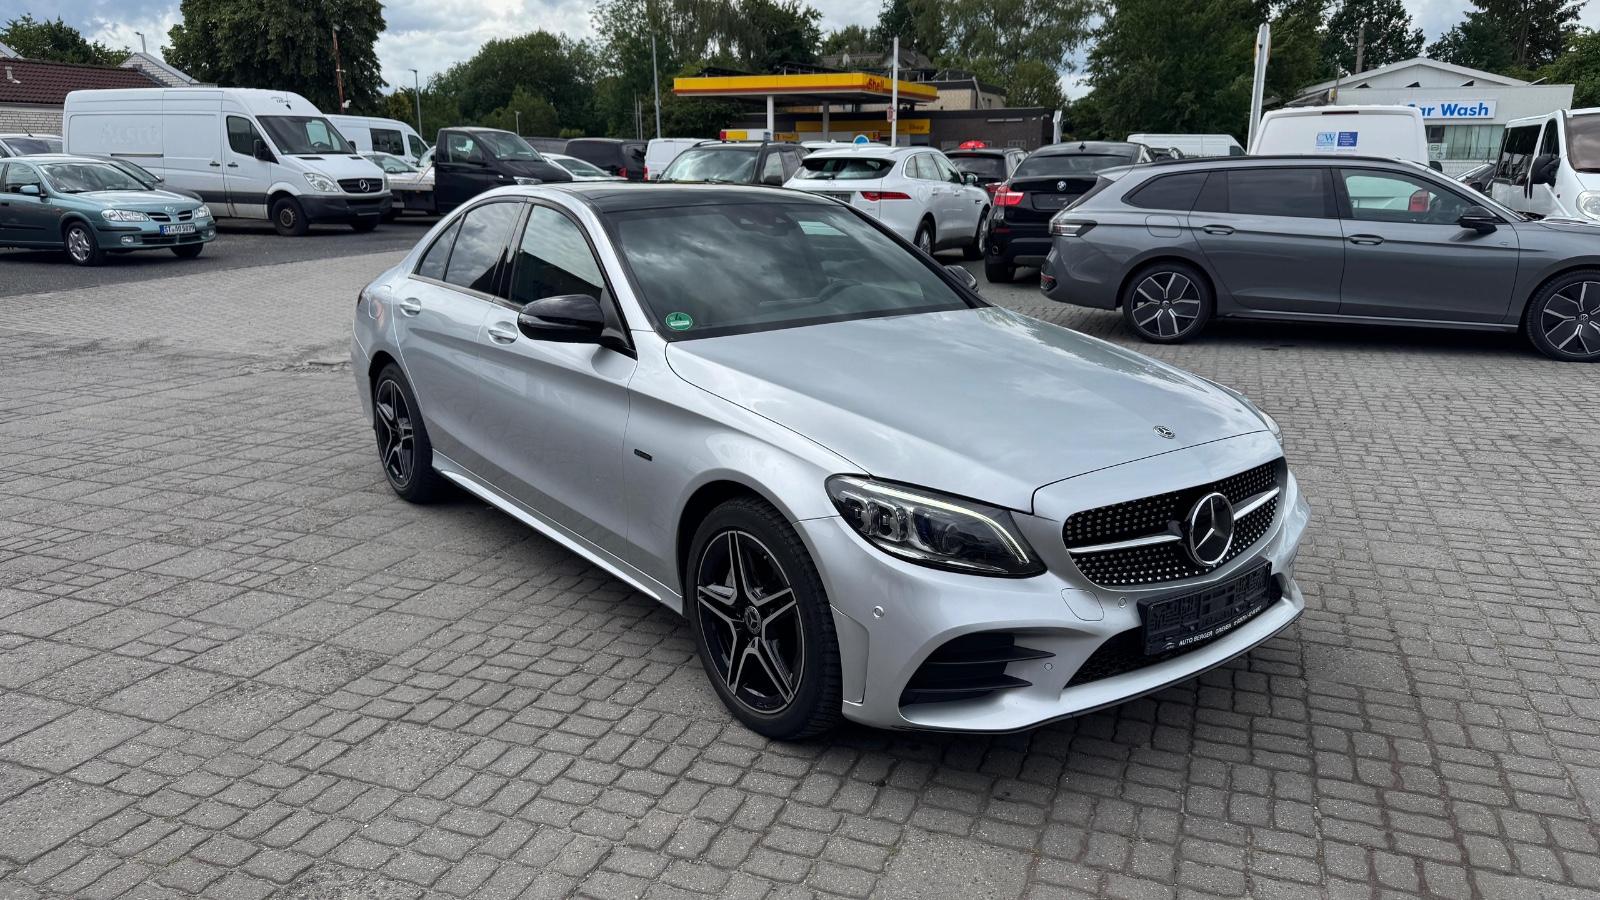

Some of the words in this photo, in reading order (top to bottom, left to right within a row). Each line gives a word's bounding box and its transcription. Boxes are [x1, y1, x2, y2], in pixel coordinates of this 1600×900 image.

[869, 78, 885, 90] Shell
[1408, 104, 1435, 117] ar
[1441, 102, 1489, 117] Wash
[1179, 637, 1193, 646] AUTO
[1193, 630, 1213, 641] BERGER
